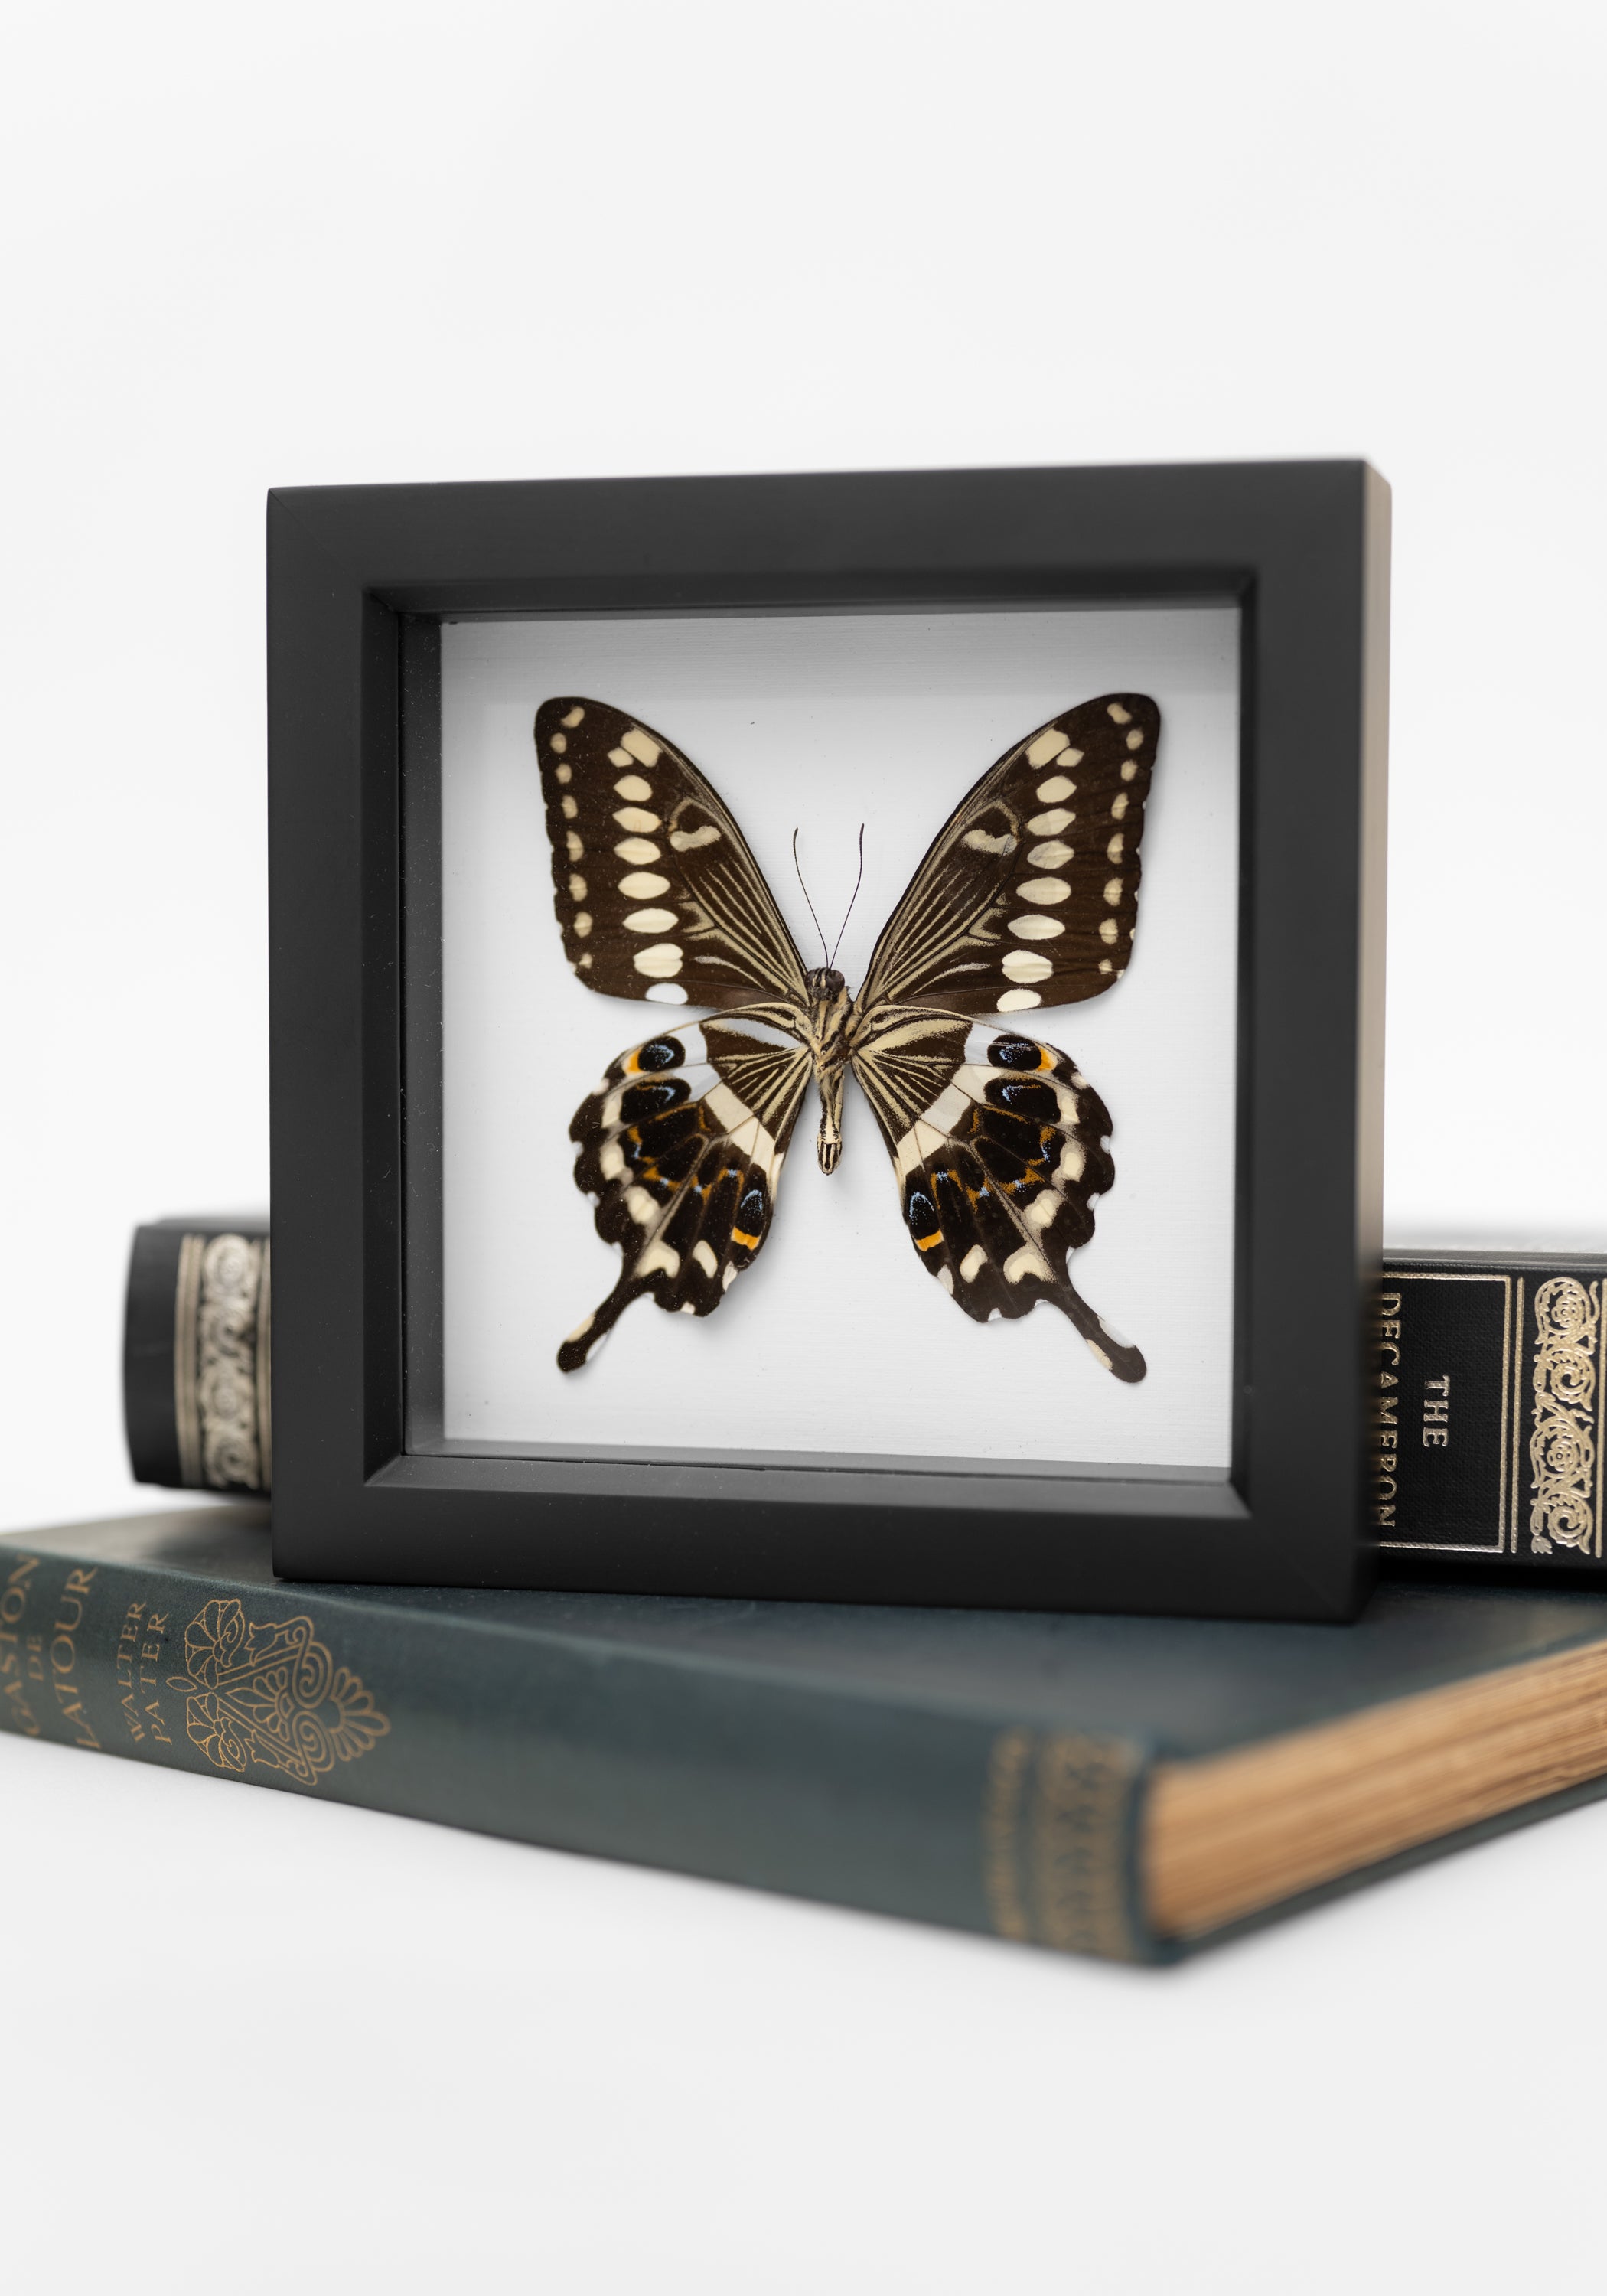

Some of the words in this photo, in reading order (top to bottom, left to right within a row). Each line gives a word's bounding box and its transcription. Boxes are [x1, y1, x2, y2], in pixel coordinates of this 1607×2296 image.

[1376, 1292, 1401, 1528] DECAMERON
[1423, 1374, 1450, 1448] THE
[0, 1554, 40, 1736] GASTON
[27, 1635, 44, 1681] DE
[50, 1567, 101, 1749] LATOUR
[117, 1601, 147, 1743] WALTER
[140, 1612, 172, 1745] PATER
